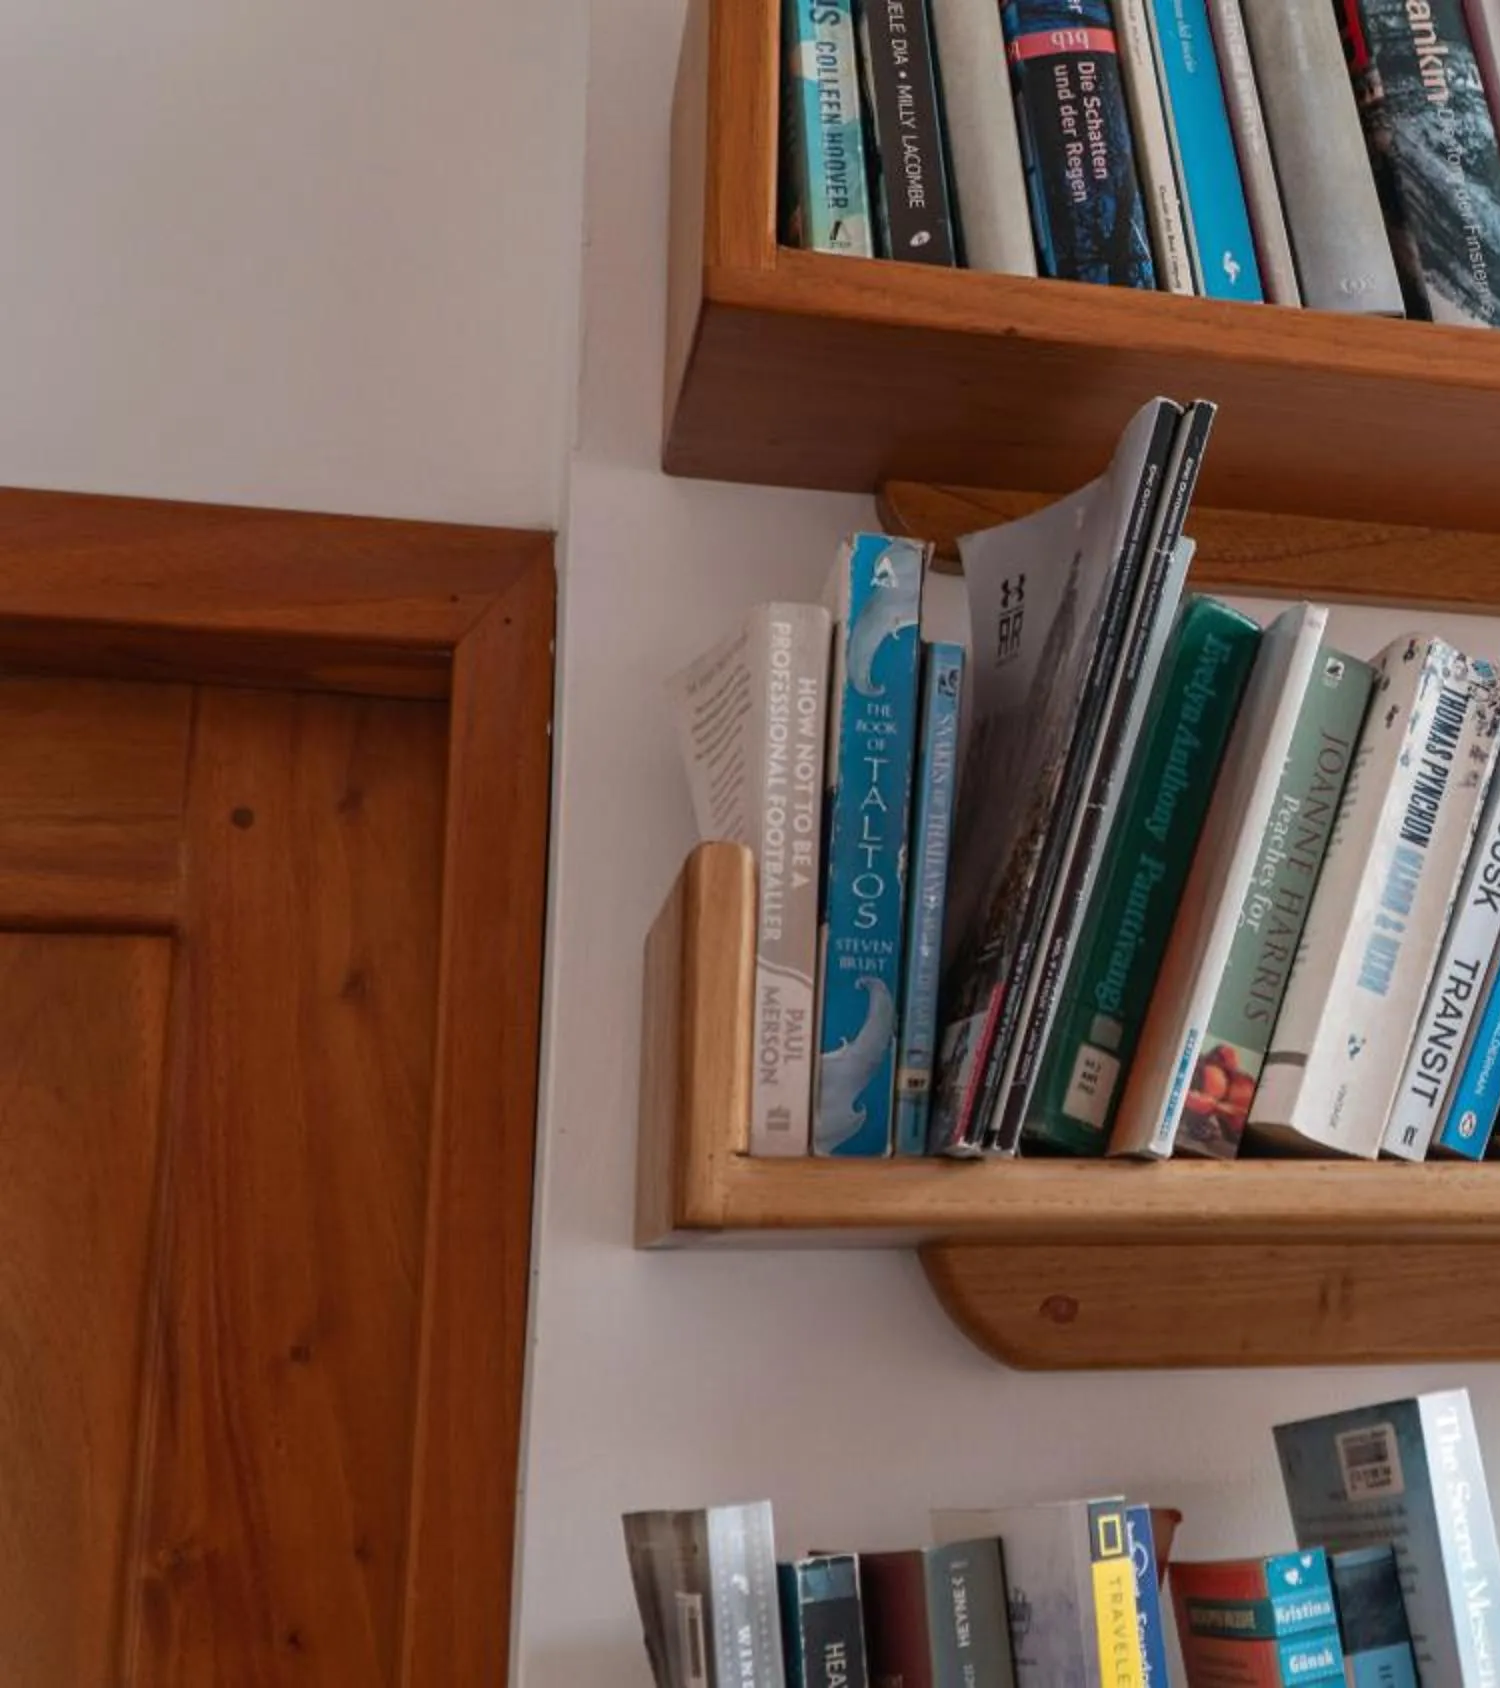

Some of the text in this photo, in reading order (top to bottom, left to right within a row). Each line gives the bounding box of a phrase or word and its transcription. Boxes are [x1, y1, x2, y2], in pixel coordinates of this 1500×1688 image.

[891, 38, 909, 65] DIA
[1407, 0, 1449, 102] ankin
[815, 41, 848, 209] COLLEEN HOOVER
[896, 84, 926, 209] MILLY LACOMBE
[1053, 63, 1087, 204] und der Regen
[1077, 61, 1108, 181] Die Schatten
[855, 720, 897, 735] BOOK
[866, 702, 892, 718] THE
[867, 738, 887, 751] OF
[1401, 686, 1470, 848] THOMAS PYNCHON
[762, 621, 792, 941] PROFESSIONAL FOOTBALLER
[791, 677, 818, 889] HOW NOT TO BE A
[1095, 634, 1231, 1012] Evelyn Anthony Panttivangi
[852, 757, 889, 929] TALTOS
[1243, 726, 1349, 1023] JOANNE HARRIS
[1249, 794, 1300, 933] Peaches for
[835, 938, 894, 954] STEVEN
[839, 956, 888, 972] BRUST
[760, 985, 783, 1085] MERSON
[784, 1008, 806, 1066] PAUL
[1411, 959, 1480, 1109] TRANSIT
[1435, 1406, 1462, 1471] The
[1450, 1481, 1478, 1573] Secret
[825, 1642, 848, 1688] HEA
[953, 1586, 971, 1649] HEYNE
[1109, 1575, 1132, 1688] TRAVELE
[1275, 1600, 1331, 1623] Kristina
